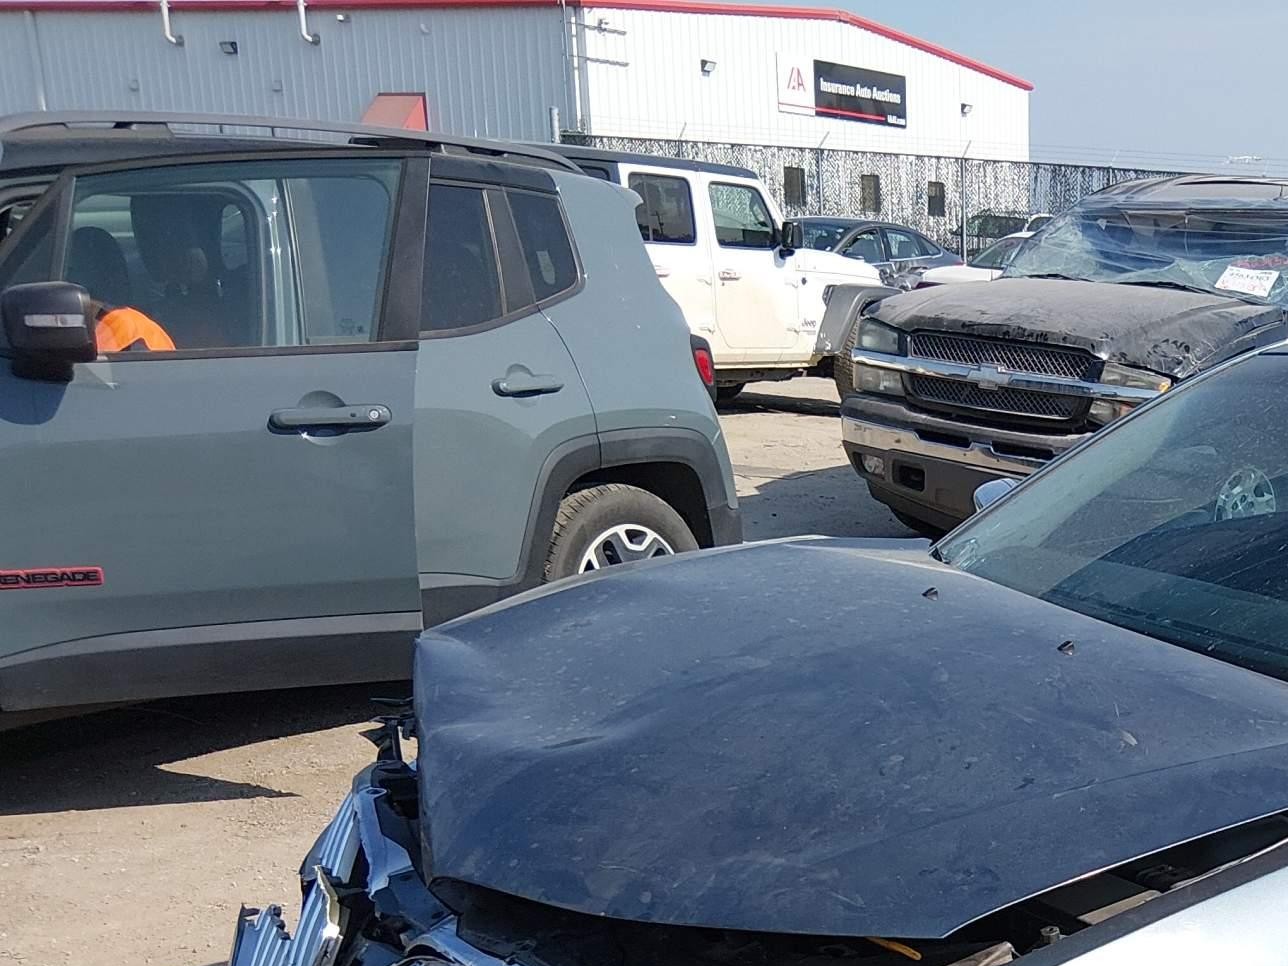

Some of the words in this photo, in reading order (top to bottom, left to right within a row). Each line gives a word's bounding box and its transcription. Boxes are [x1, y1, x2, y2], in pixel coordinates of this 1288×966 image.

[820, 77, 855, 97] Insurance
[856, 83, 872, 100] Auto
[872, 86, 901, 104] Auctions
[0, 571, 98, 585] ENEGADE
